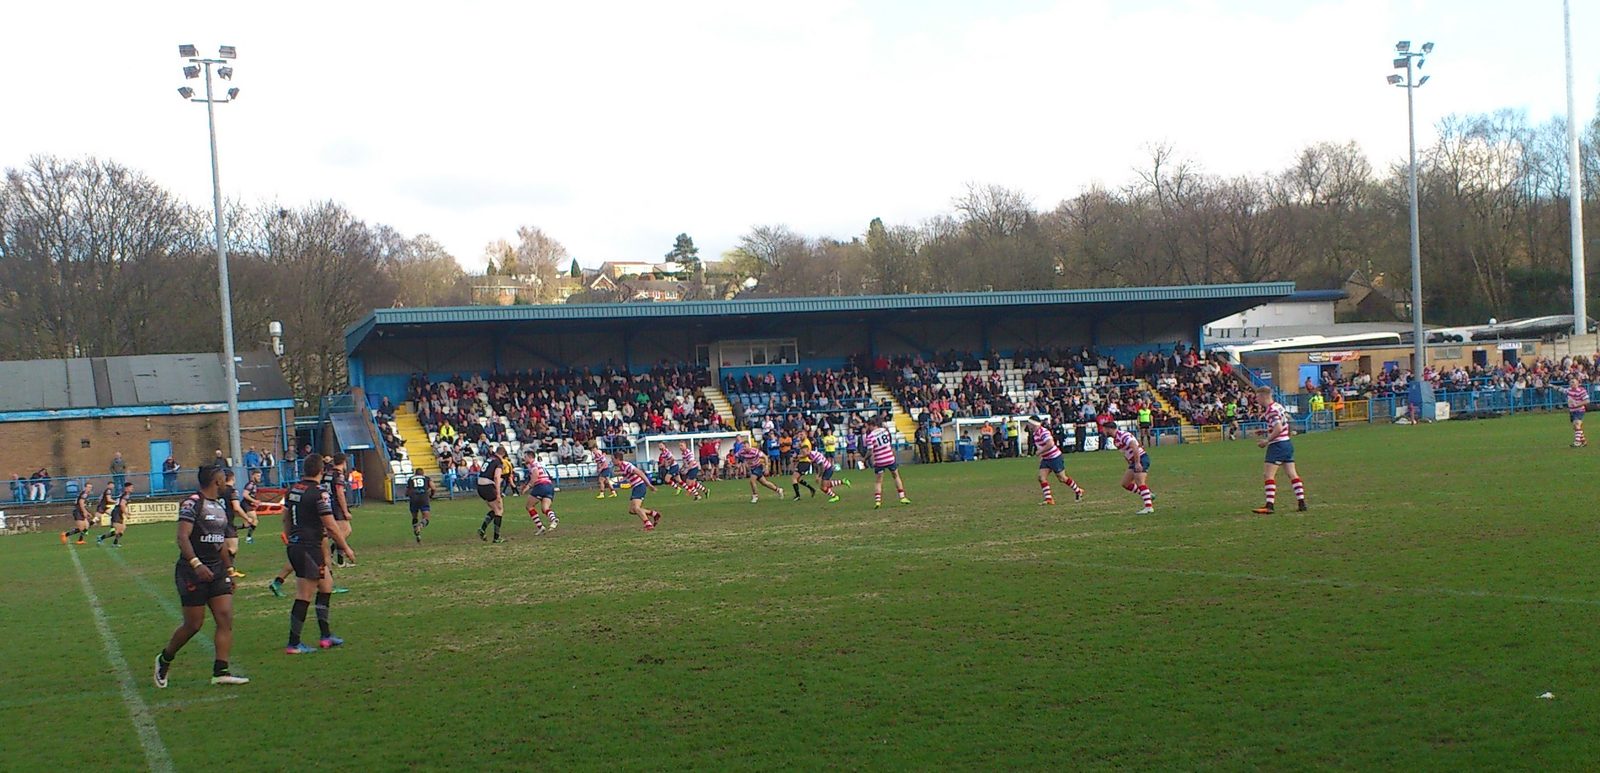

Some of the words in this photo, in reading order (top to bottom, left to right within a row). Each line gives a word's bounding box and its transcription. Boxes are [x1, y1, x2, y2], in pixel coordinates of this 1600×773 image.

[876, 434, 889, 446] 18
[413, 478, 425, 488] 19
[139, 503, 177, 512] LIMITED
[291, 504, 298, 526] 1
